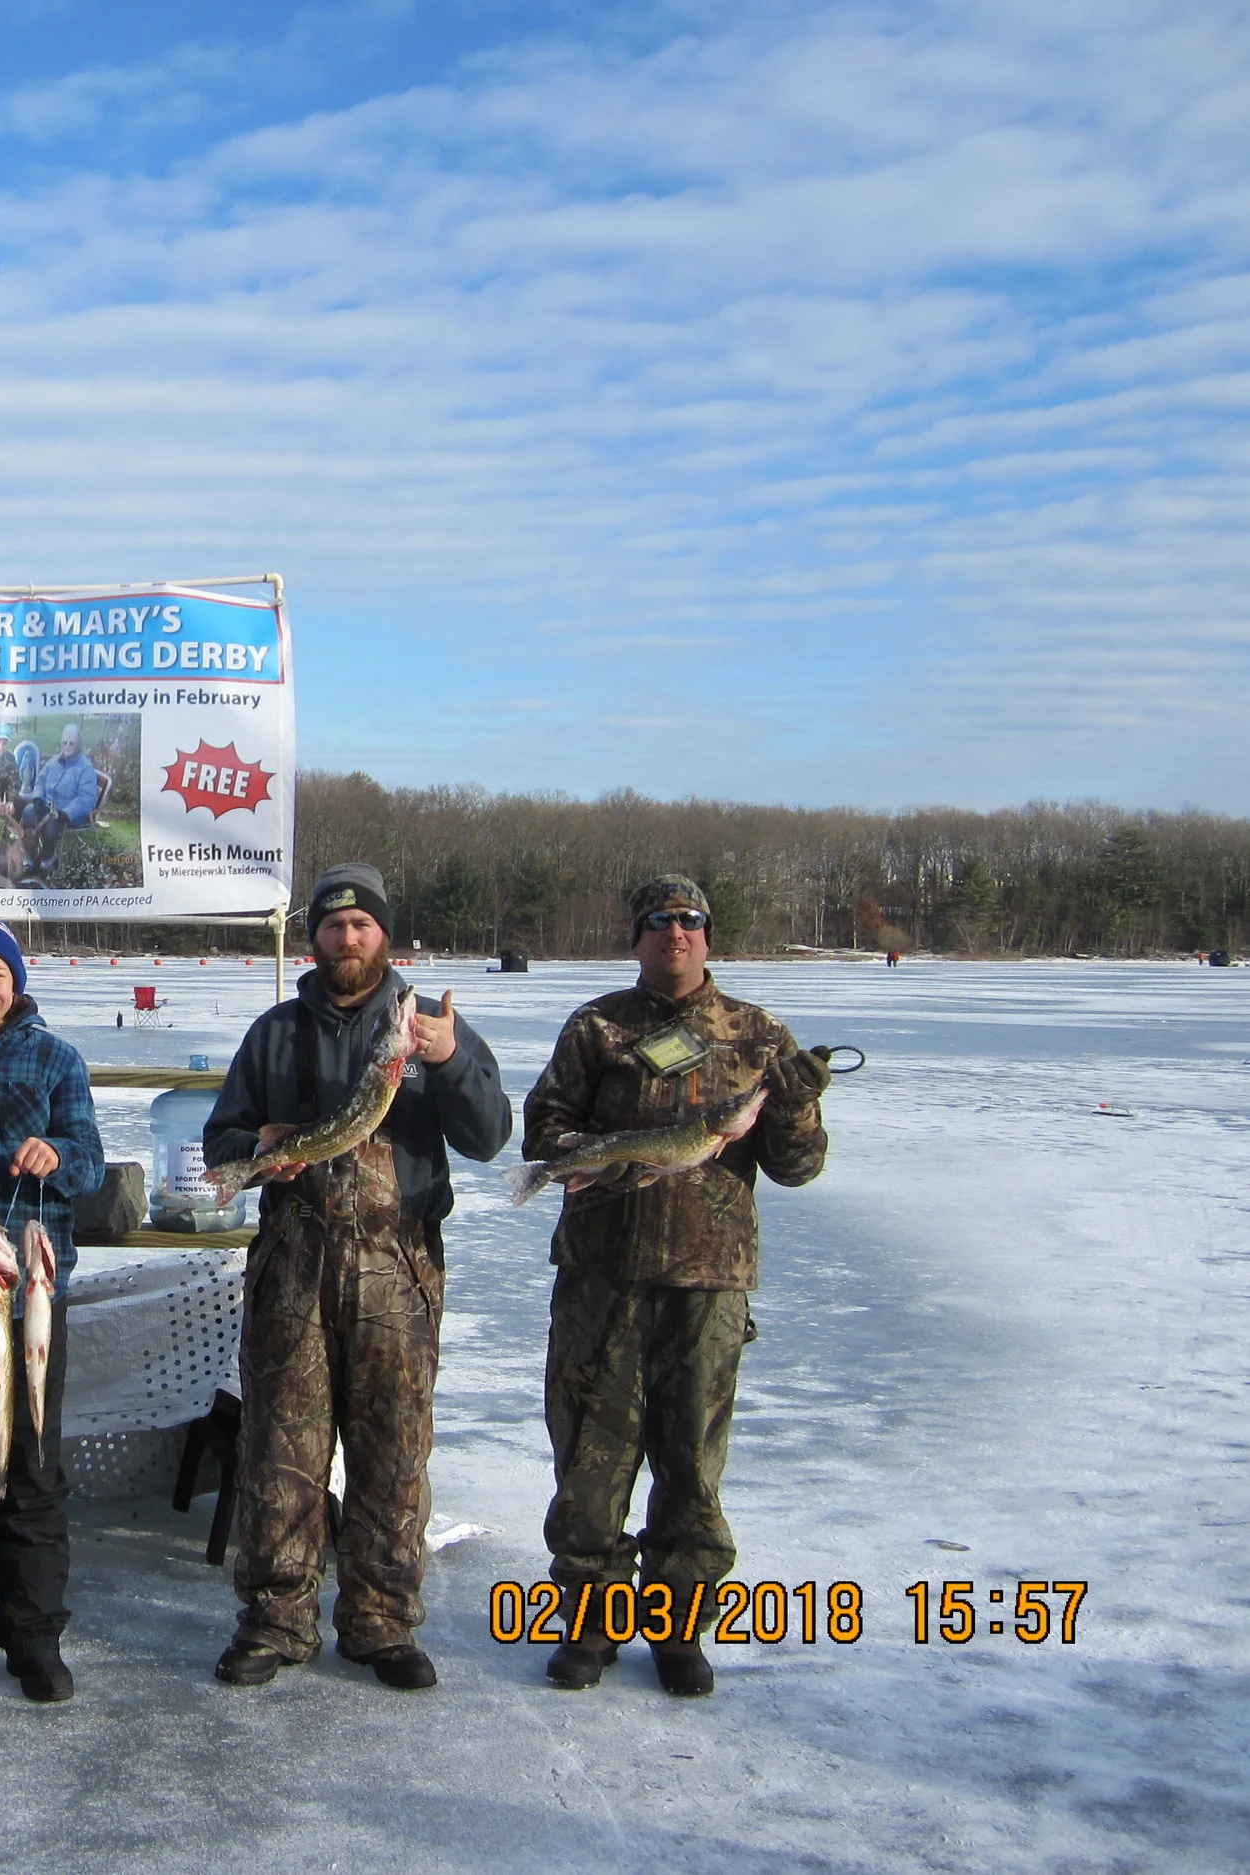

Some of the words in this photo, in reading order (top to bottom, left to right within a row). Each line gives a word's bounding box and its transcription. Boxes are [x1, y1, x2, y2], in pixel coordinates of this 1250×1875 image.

[22, 611, 46, 638] &
[54, 605, 182, 636] MARY'S
[9, 641, 142, 673] FISHING
[153, 640, 269, 672] DERBY
[41, 691, 63, 708] 1st
[67, 688, 148, 709] Saturday
[153, 688, 171, 705] in
[176, 689, 262, 710] February
[181, 760, 251, 799] FREE
[147, 845, 184, 862] Free
[188, 843, 222, 861] Fish
[226, 844, 284, 863] Mount
[159, 867, 169, 879] by
[171, 866, 227, 878] Mierzejewski
[228, 865, 272, 876] Taxidermy
[16, 895, 70, 909] Sportsmen
[72, 895, 85, 907] of
[85, 896, 100, 907] PA
[101, 894, 153, 909] Accepted
